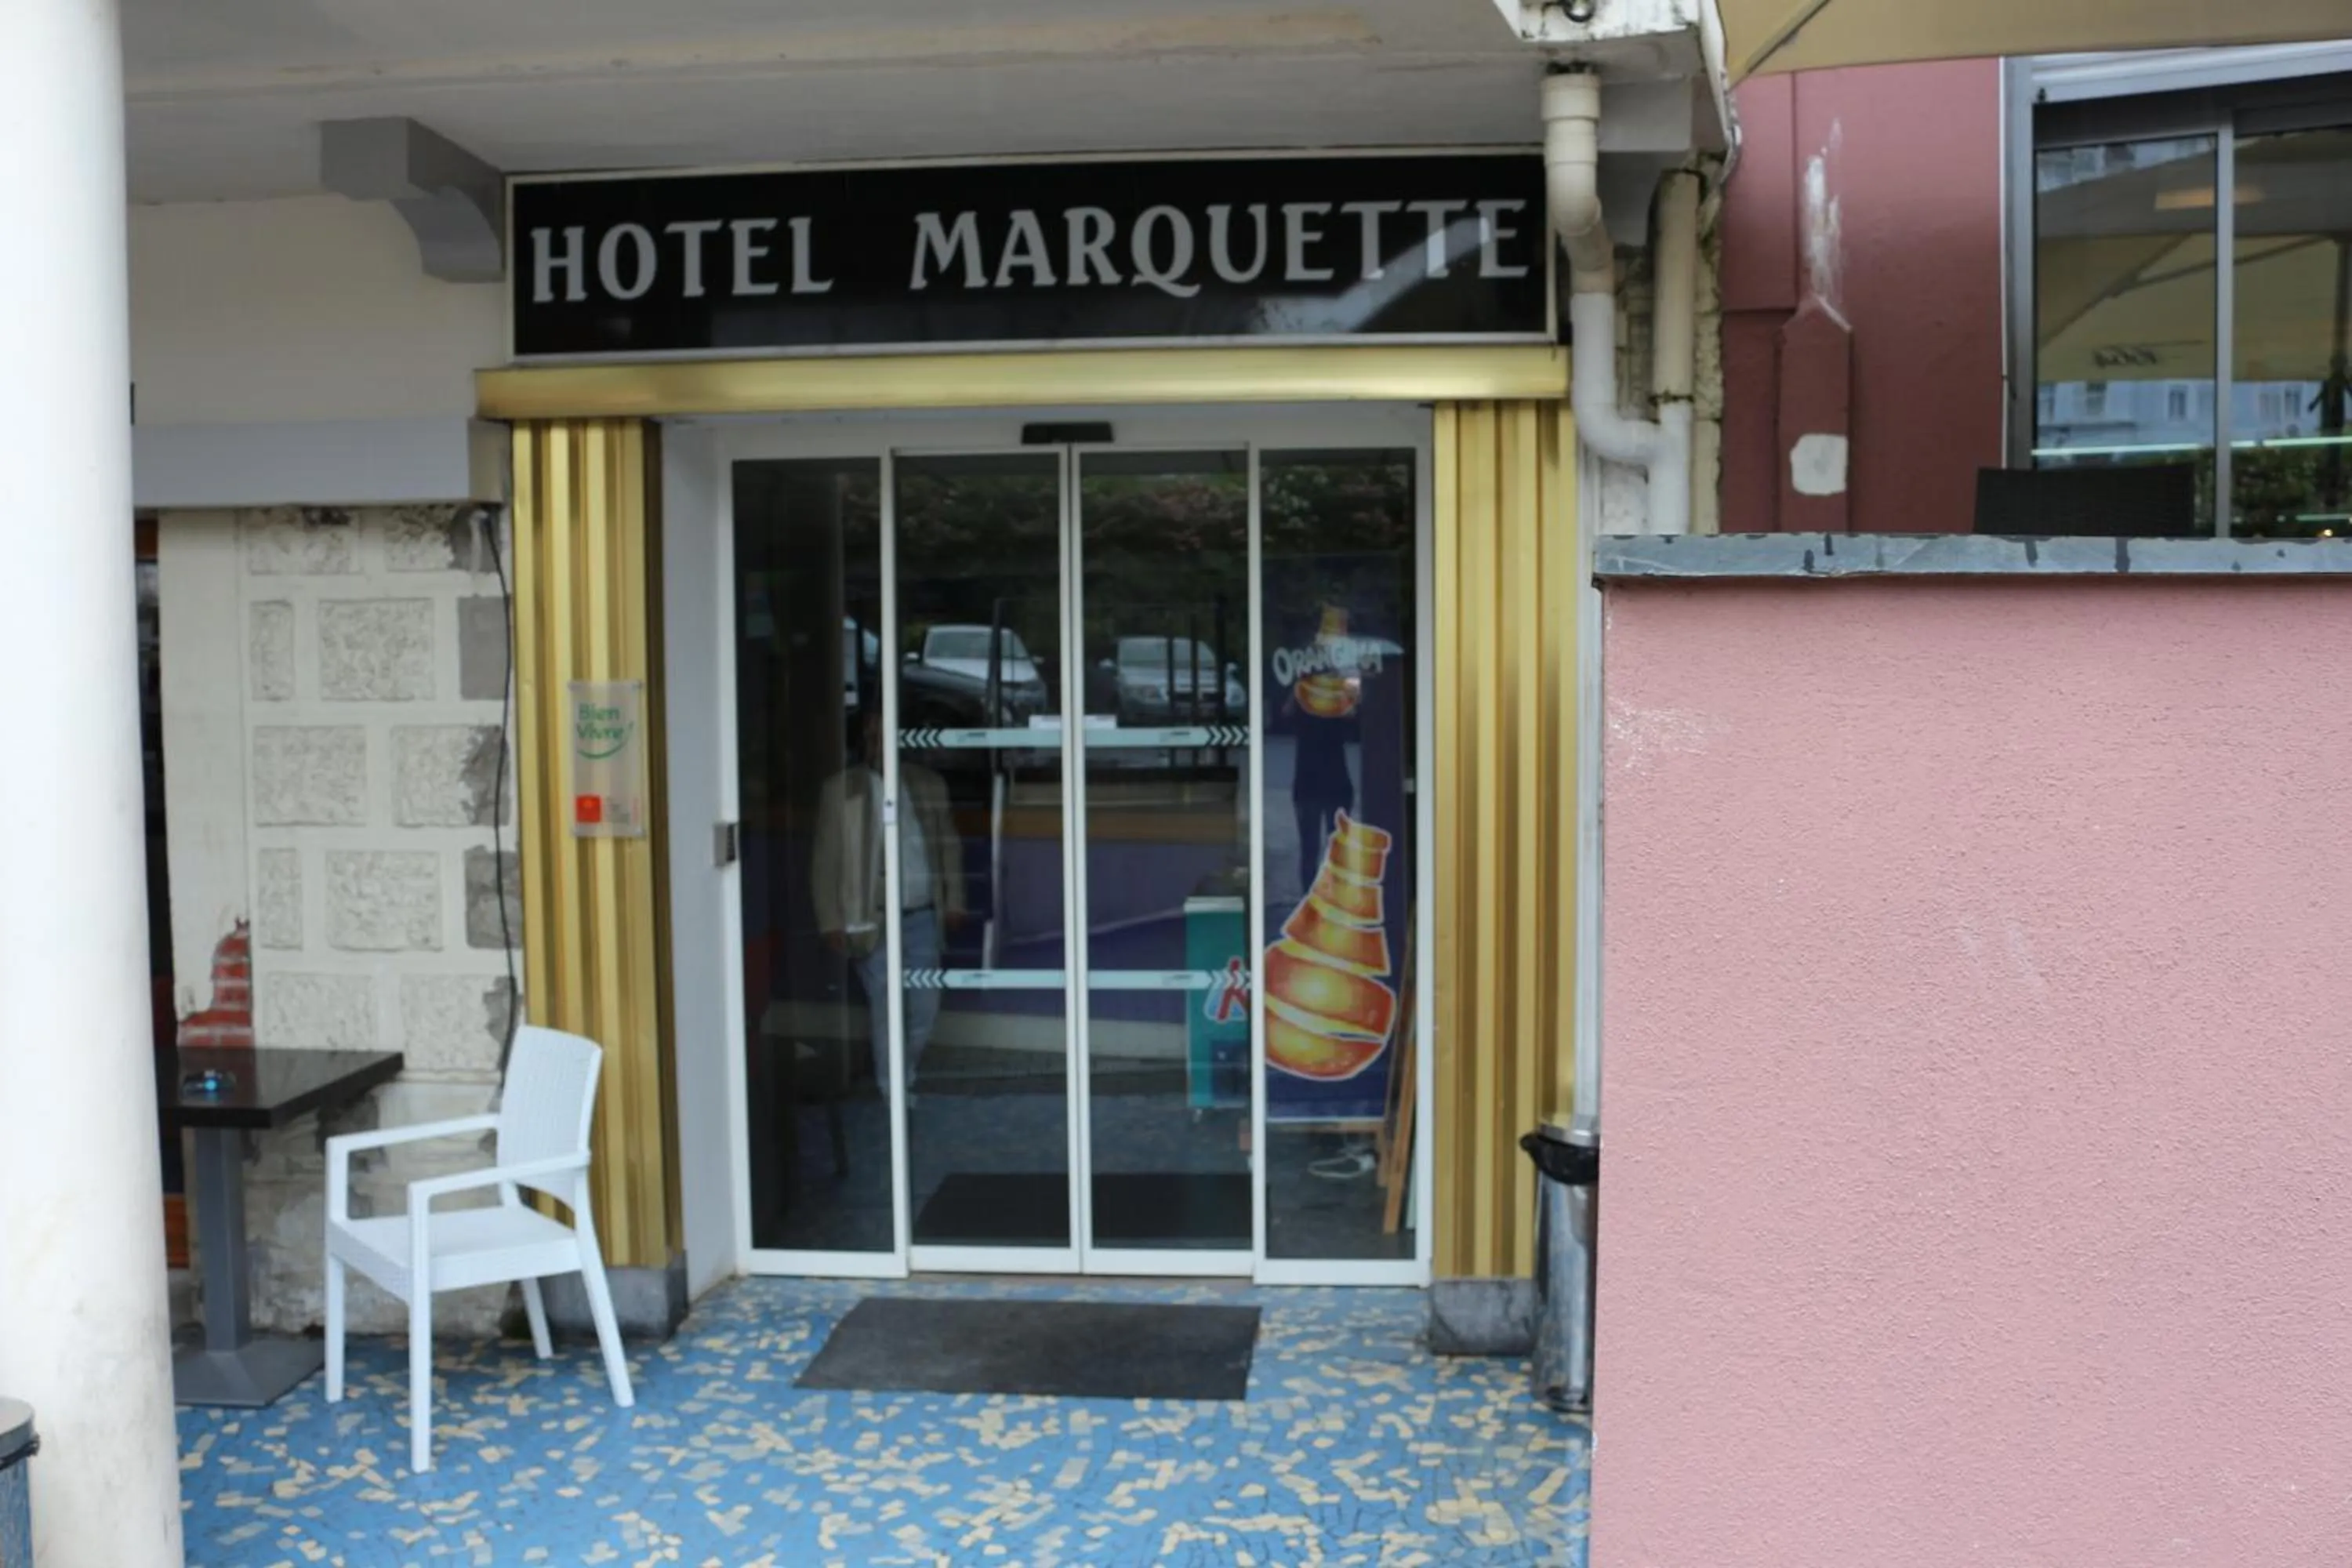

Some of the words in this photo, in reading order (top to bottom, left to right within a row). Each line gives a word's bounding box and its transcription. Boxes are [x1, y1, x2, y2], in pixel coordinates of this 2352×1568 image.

[530, 216, 833, 303] HOTEL
[909, 199, 1529, 298] MARQUETTE
[579, 703, 620, 721] Bien
